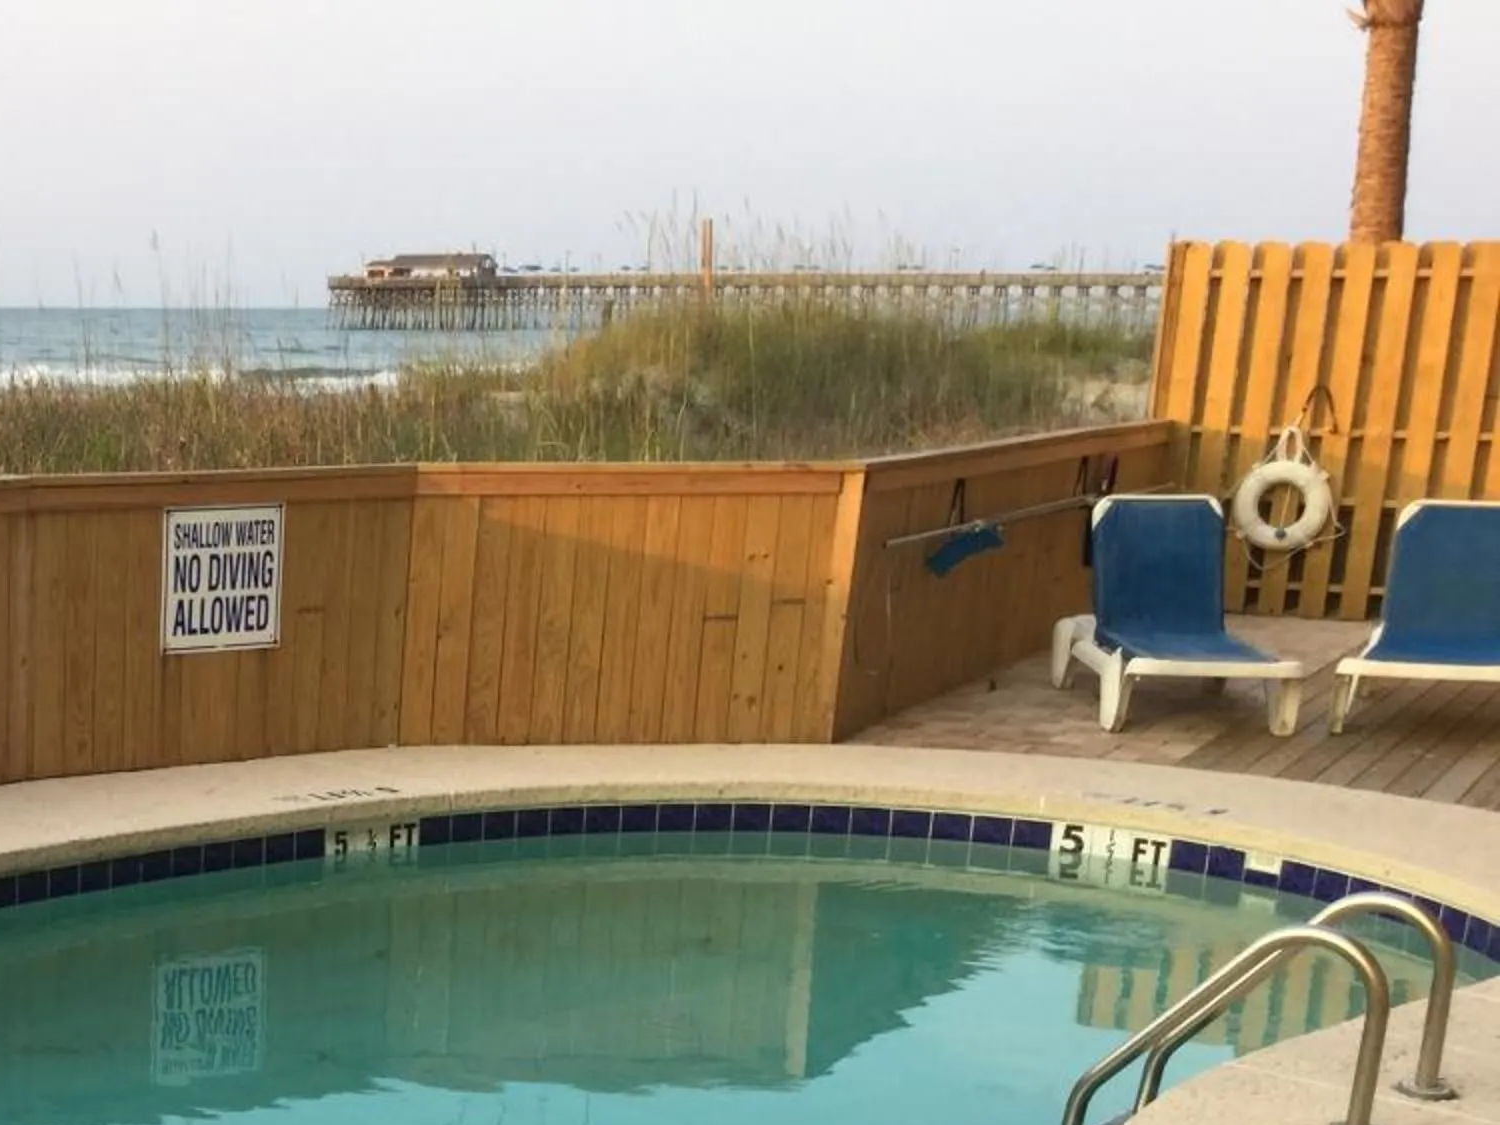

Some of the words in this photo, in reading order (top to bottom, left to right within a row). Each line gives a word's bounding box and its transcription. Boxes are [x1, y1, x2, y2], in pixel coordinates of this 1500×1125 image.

[174, 521, 233, 549] SHALLOW
[235, 519, 275, 547] WATER
[173, 554, 201, 593] NO
[208, 550, 274, 592] DIVING
[172, 595, 269, 636] ALLOWED
[334, 831, 348, 855] 5
[390, 823, 417, 848] FT
[1062, 825, 1084, 853] 5
[1132, 837, 1167, 866] FT
